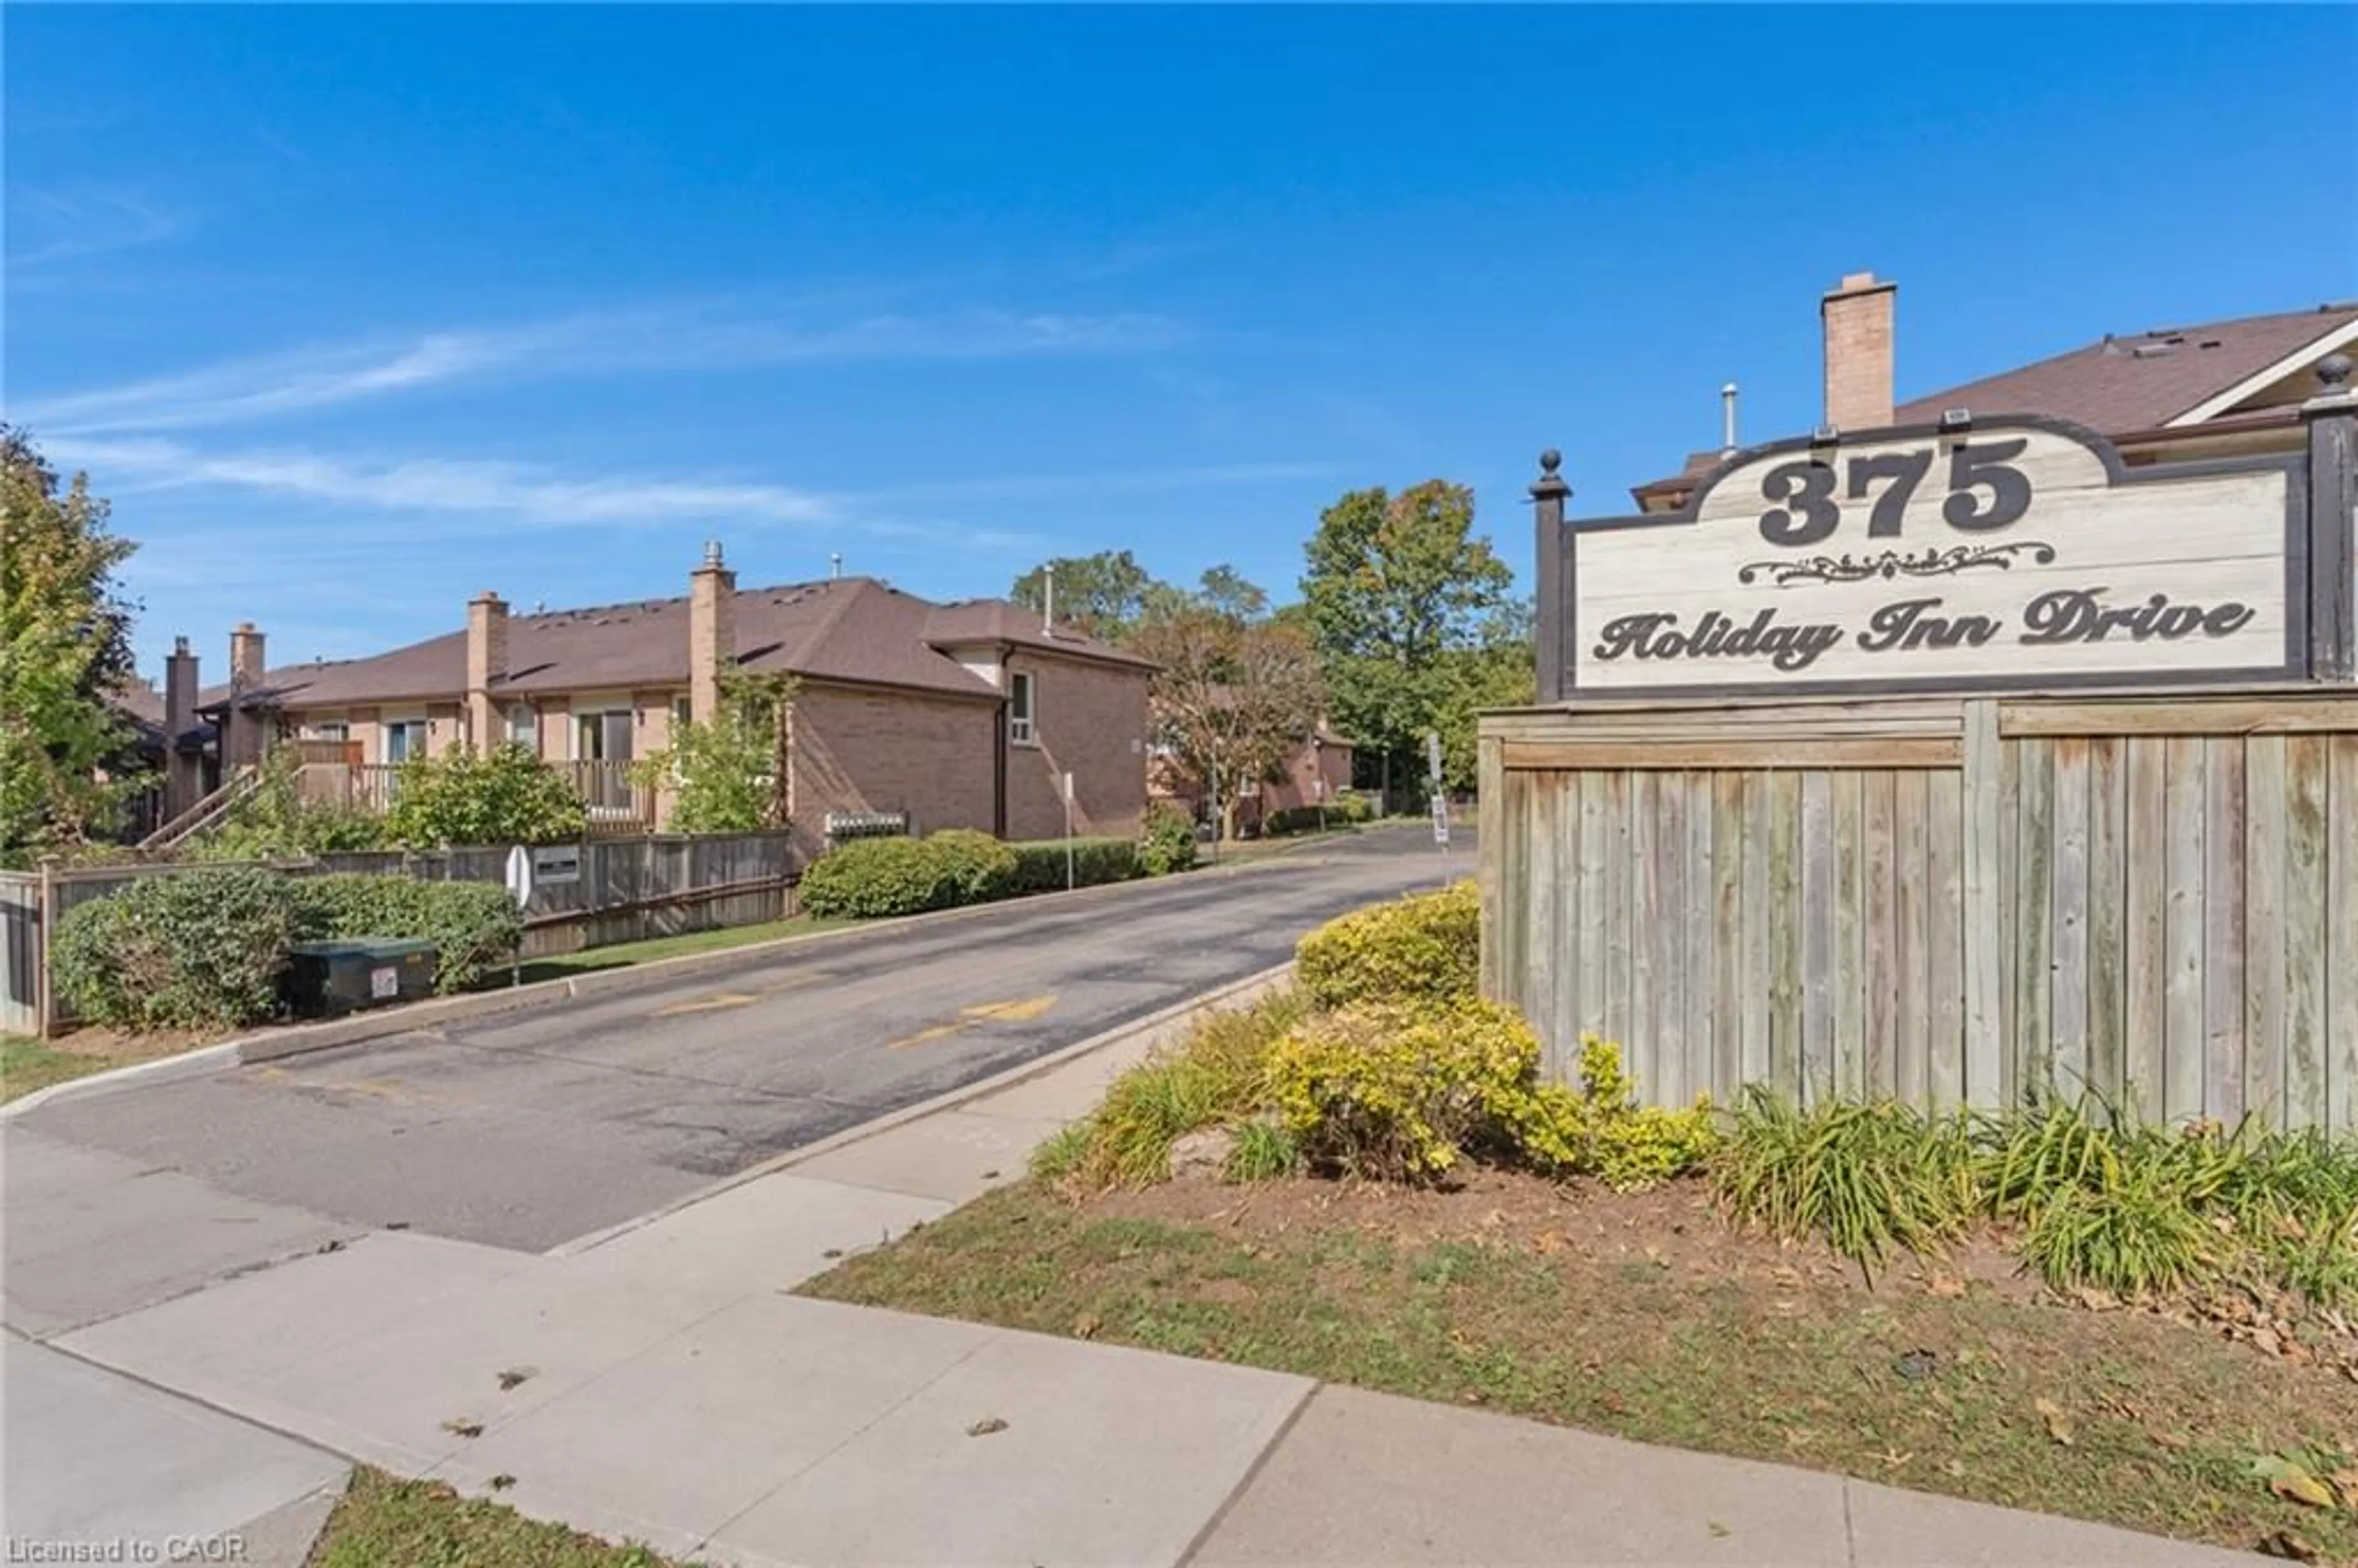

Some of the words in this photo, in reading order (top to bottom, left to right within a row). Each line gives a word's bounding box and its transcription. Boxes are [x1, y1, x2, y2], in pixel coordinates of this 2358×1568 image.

[1759, 438, 2032, 547] 375
[1593, 608, 1845, 672] Holiday
[1857, 597, 2002, 652] Inn
[2018, 586, 2255, 644] Drive
